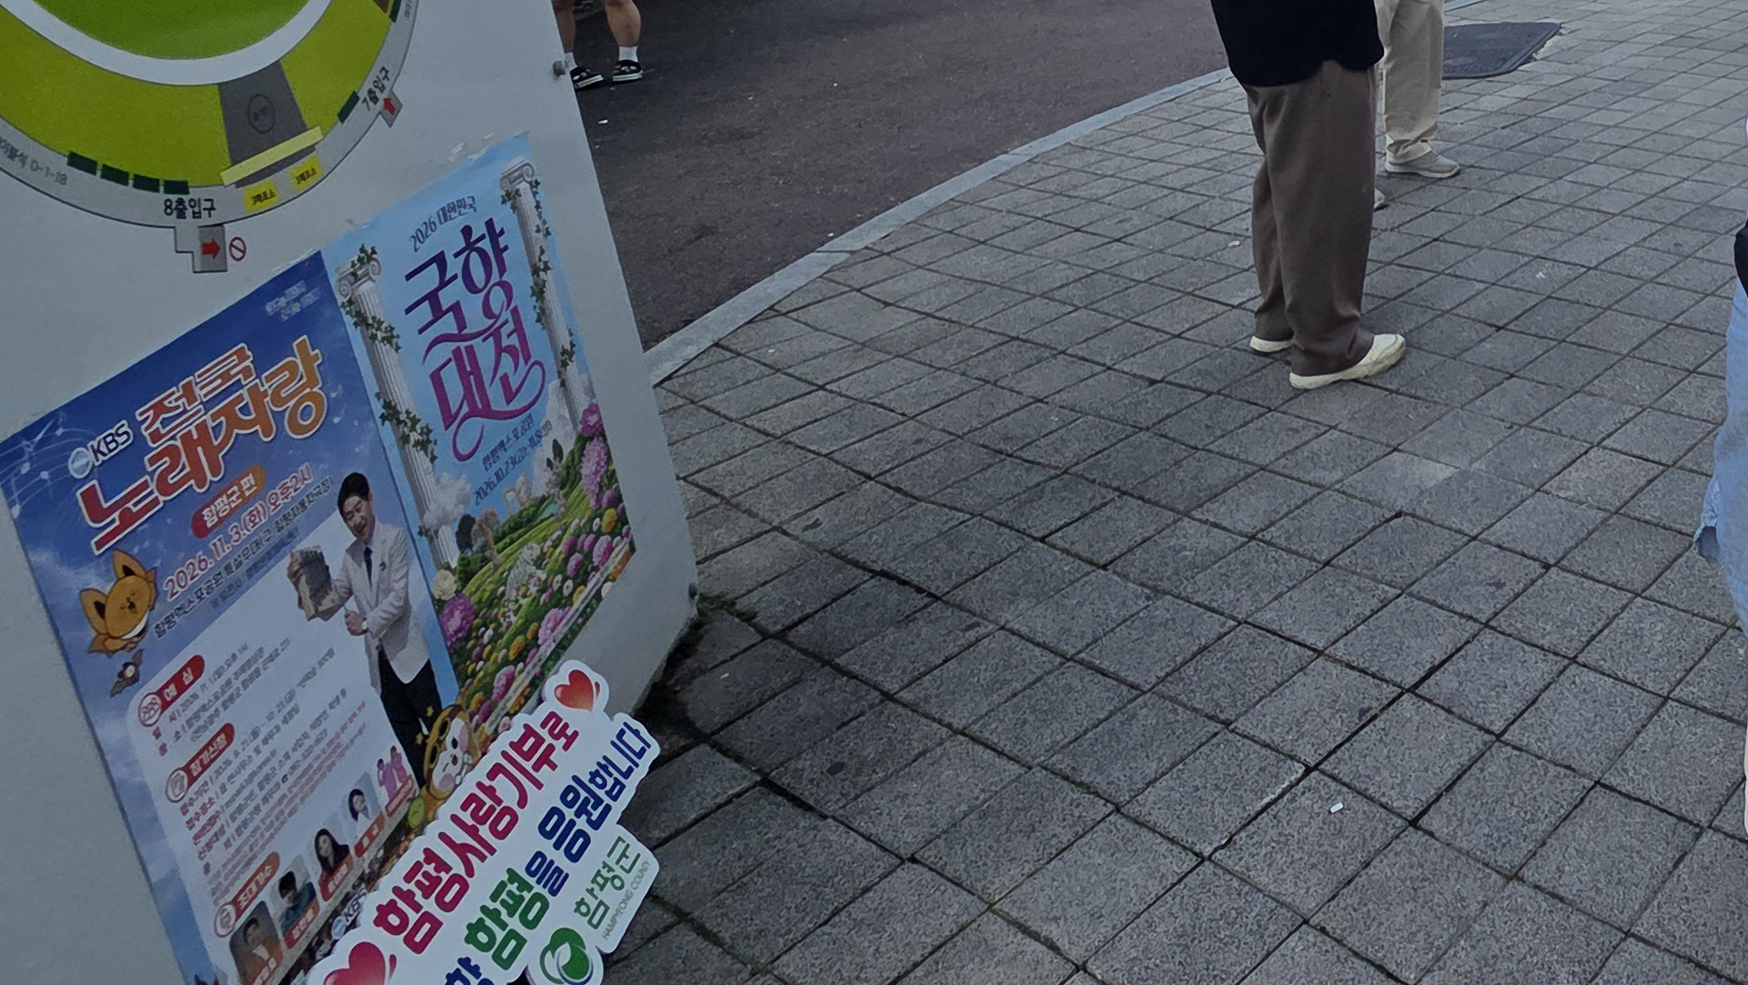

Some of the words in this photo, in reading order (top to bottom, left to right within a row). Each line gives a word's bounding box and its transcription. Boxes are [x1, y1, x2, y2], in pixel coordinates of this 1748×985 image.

[163, 197, 216, 220] 8출입구
[410, 217, 437, 252] 2026
[438, 195, 477, 226] 대한민국
[405, 217, 513, 362] 국향
[137, 344, 254, 446] 전국
[429, 305, 546, 459] 대전
[78, 336, 327, 554] 노래자랑
[90, 420, 132, 465] KBS
[164, 550, 213, 602] 2026.
[210, 533, 231, 560] 11.
[267, 462, 313, 512] 오후2시
[202, 485, 243, 528] 함평군
[239, 472, 258, 497] 편
[154, 569, 222, 638] 함평엑스포공원
[189, 732, 228, 775] 참가신청
[373, 710, 580, 955] 함평사랑기부로
[464, 850, 570, 971] 함평을
[537, 721, 652, 864] 응원합니다
[238, 863, 276, 909] 초대가수
[574, 835, 641, 930] 함평군
